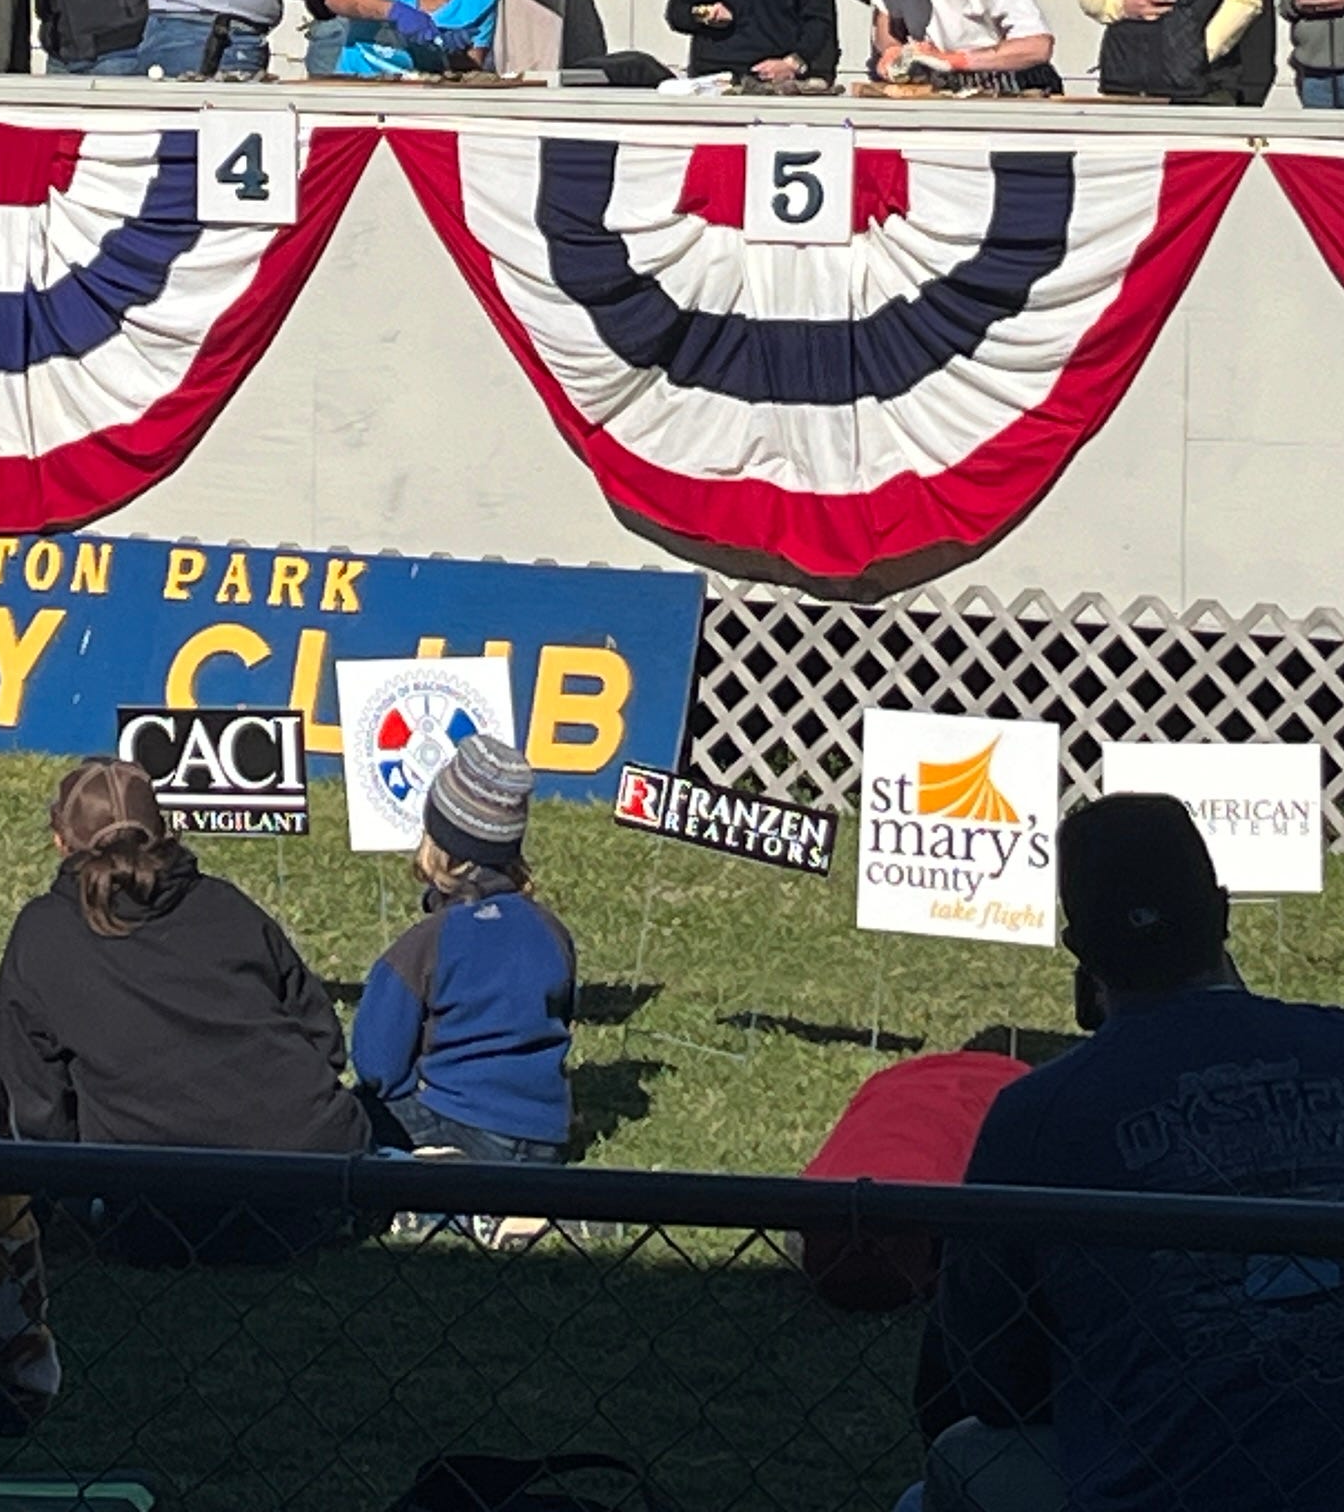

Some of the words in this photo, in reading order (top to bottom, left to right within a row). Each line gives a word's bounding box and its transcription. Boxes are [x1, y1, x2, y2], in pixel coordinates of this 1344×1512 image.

[213, 131, 271, 202] 4
[771, 150, 825, 225] 5
[163, 548, 367, 613] PARK
[165, 622, 632, 774] CLB
[119, 715, 305, 789] CACI
[192, 810, 306, 832] VIGILANT
[668, 778, 829, 848] FRANZEN
[870, 773, 913, 816] st
[1183, 799, 1310, 820] MERICAN
[664, 810, 828, 870] REALTORS
[868, 814, 1050, 880] mary's
[1207, 820, 1310, 836] STEMS
[866, 861, 984, 902] county
[929, 899, 977, 921] take
[979, 901, 1045, 932] flight
